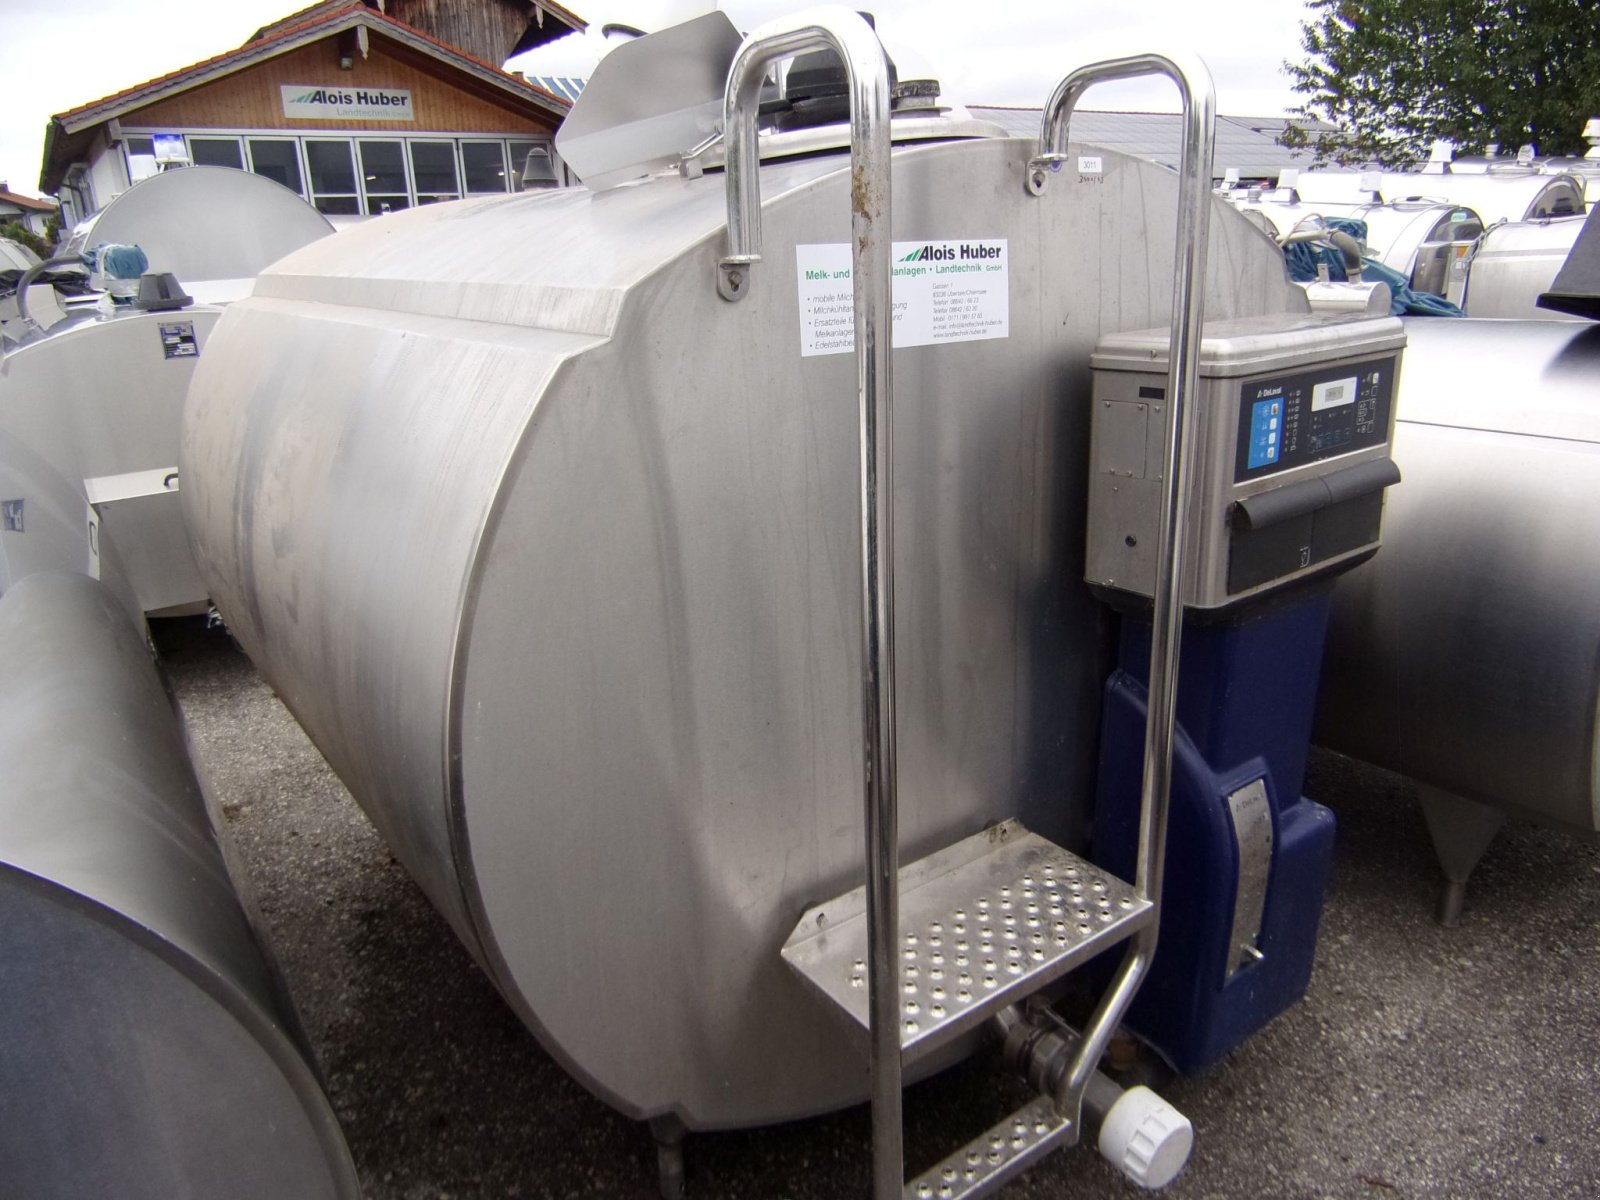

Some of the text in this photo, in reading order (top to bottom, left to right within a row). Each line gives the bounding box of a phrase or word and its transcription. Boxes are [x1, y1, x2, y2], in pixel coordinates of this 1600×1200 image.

[310, 90, 408, 106] Alois Huber
[337, 108, 391, 118] Landtechnik
[917, 243, 1001, 261] Alois Huber
[805, 264, 1002, 280] Melk- und lanlagen Landtechnik GmbH
[813, 294, 835, 303] mobile
[813, 305, 854, 315] Milchkühltan
[814, 318, 846, 327] Ersatzteile
[815, 340, 855, 350] Edelstahlbe
